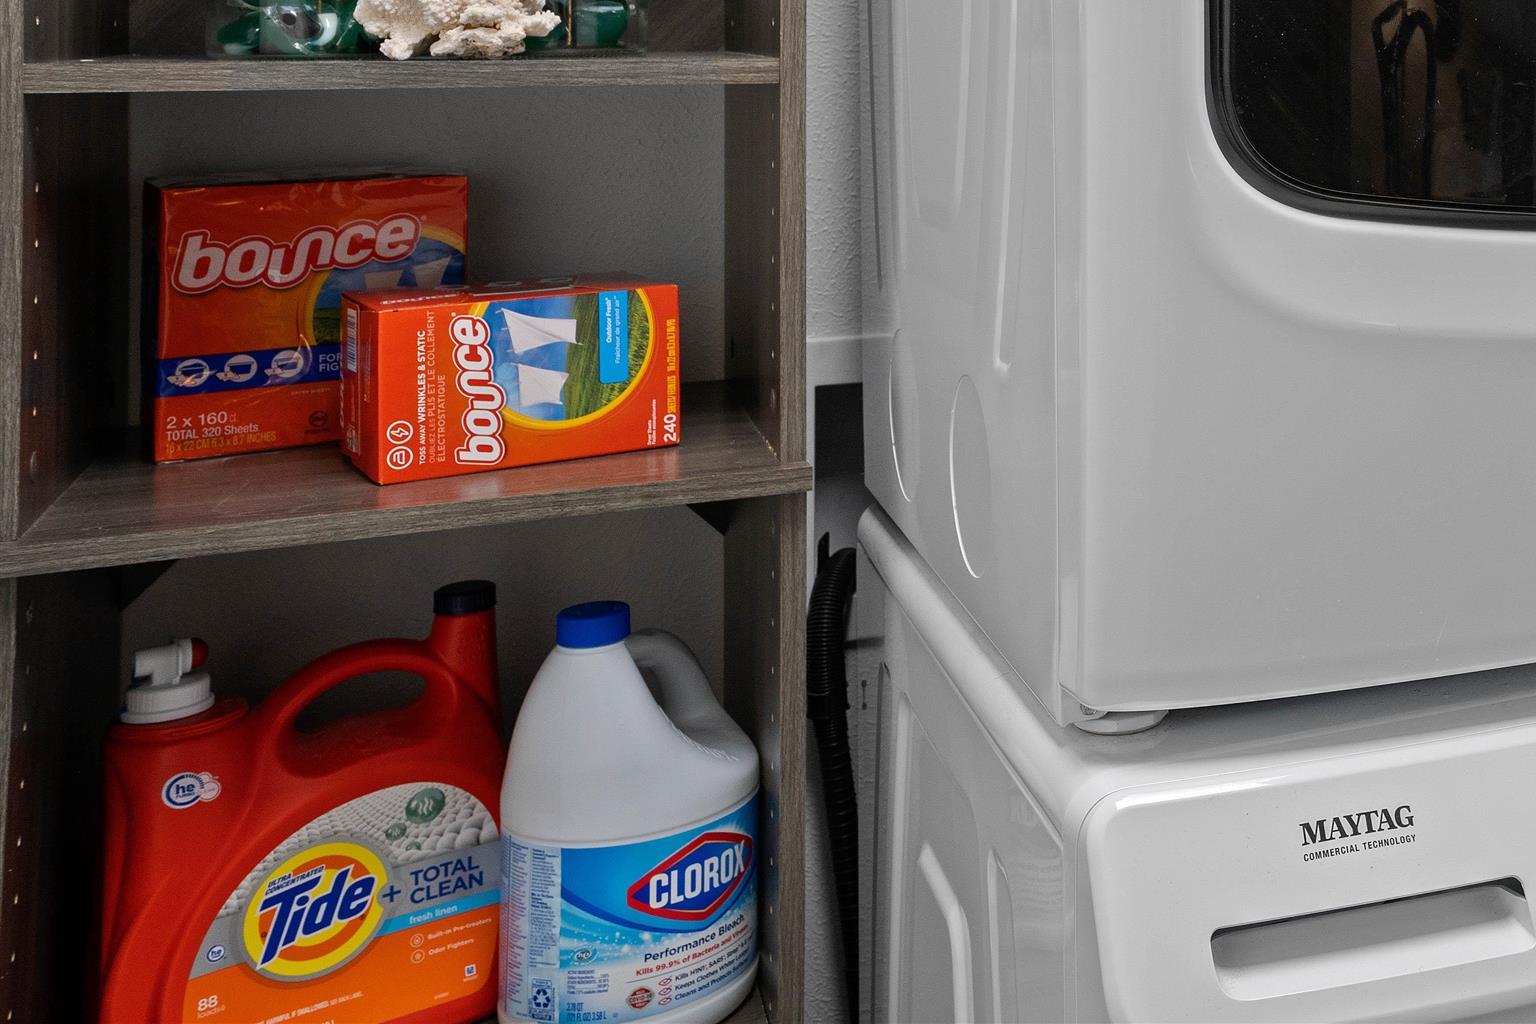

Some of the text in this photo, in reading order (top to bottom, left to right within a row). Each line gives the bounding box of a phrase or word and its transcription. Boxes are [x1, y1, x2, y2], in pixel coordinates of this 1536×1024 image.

[173, 213, 422, 293] bounce
[417, 330, 426, 362] STATIC
[427, 311, 435, 367] COLLEMENT
[427, 369, 435, 380] LE
[417, 373, 426, 423] WRINKLES
[427, 384, 435, 394] ET
[450, 314, 506, 465] bounce
[166, 416, 176, 428] 2
[182, 417, 192, 427] x
[198, 411, 228, 426] 160
[427, 397, 435, 417] PLIS
[166, 422, 259, 442] TOTAL 320 Sheets
[247, 431, 277, 444] INCHES
[664, 414, 677, 442] 240
[176, 784, 195, 794] he
[1299, 805, 1414, 846] MAYTAG
[1303, 834, 1416, 862] COMMERCIAL TECHNOLOGY
[268, 873, 292, 887] ULTRA
[410, 856, 480, 885] TOTAL
[649, 840, 745, 909] CLOROX
[410, 871, 484, 904] CLEAN
[257, 865, 376, 969] Tide
[409, 905, 458, 925] fresh linen
[428, 946, 445, 956] Odor
[644, 932, 716, 963] Performance
[718, 914, 745, 936] Bleach
[636, 967, 653, 976] Kills
[656, 960, 680, 972] 99.9%
[682, 955, 690, 963] of
[692, 944, 720, 959] Bacteria
[721, 936, 732, 946] and
[675, 980, 695, 991] Keeps
[675, 989, 696, 1000] Cleans
[198, 995, 218, 1012] 88
